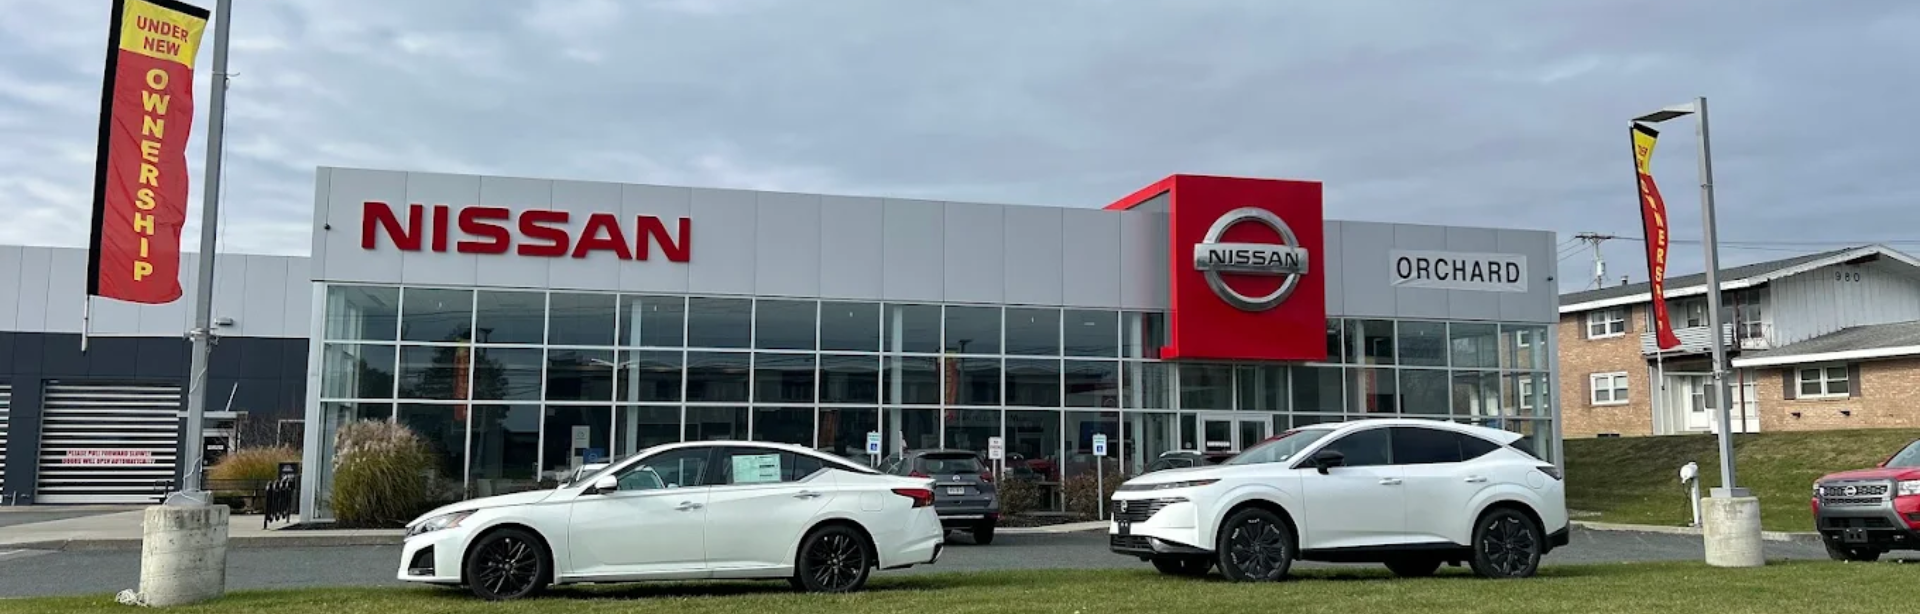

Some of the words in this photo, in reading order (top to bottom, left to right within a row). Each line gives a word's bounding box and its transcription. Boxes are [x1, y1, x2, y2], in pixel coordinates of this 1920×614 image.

[136, 15, 189, 43] UNDER
[143, 36, 181, 57] NEW
[133, 68, 170, 281] OWNERSHIP
[361, 201, 691, 263] NISSAN
[1208, 249, 1300, 268] NISSAN
[1396, 255, 1521, 284] ORCHARD
[1834, 271, 1860, 282] 980
